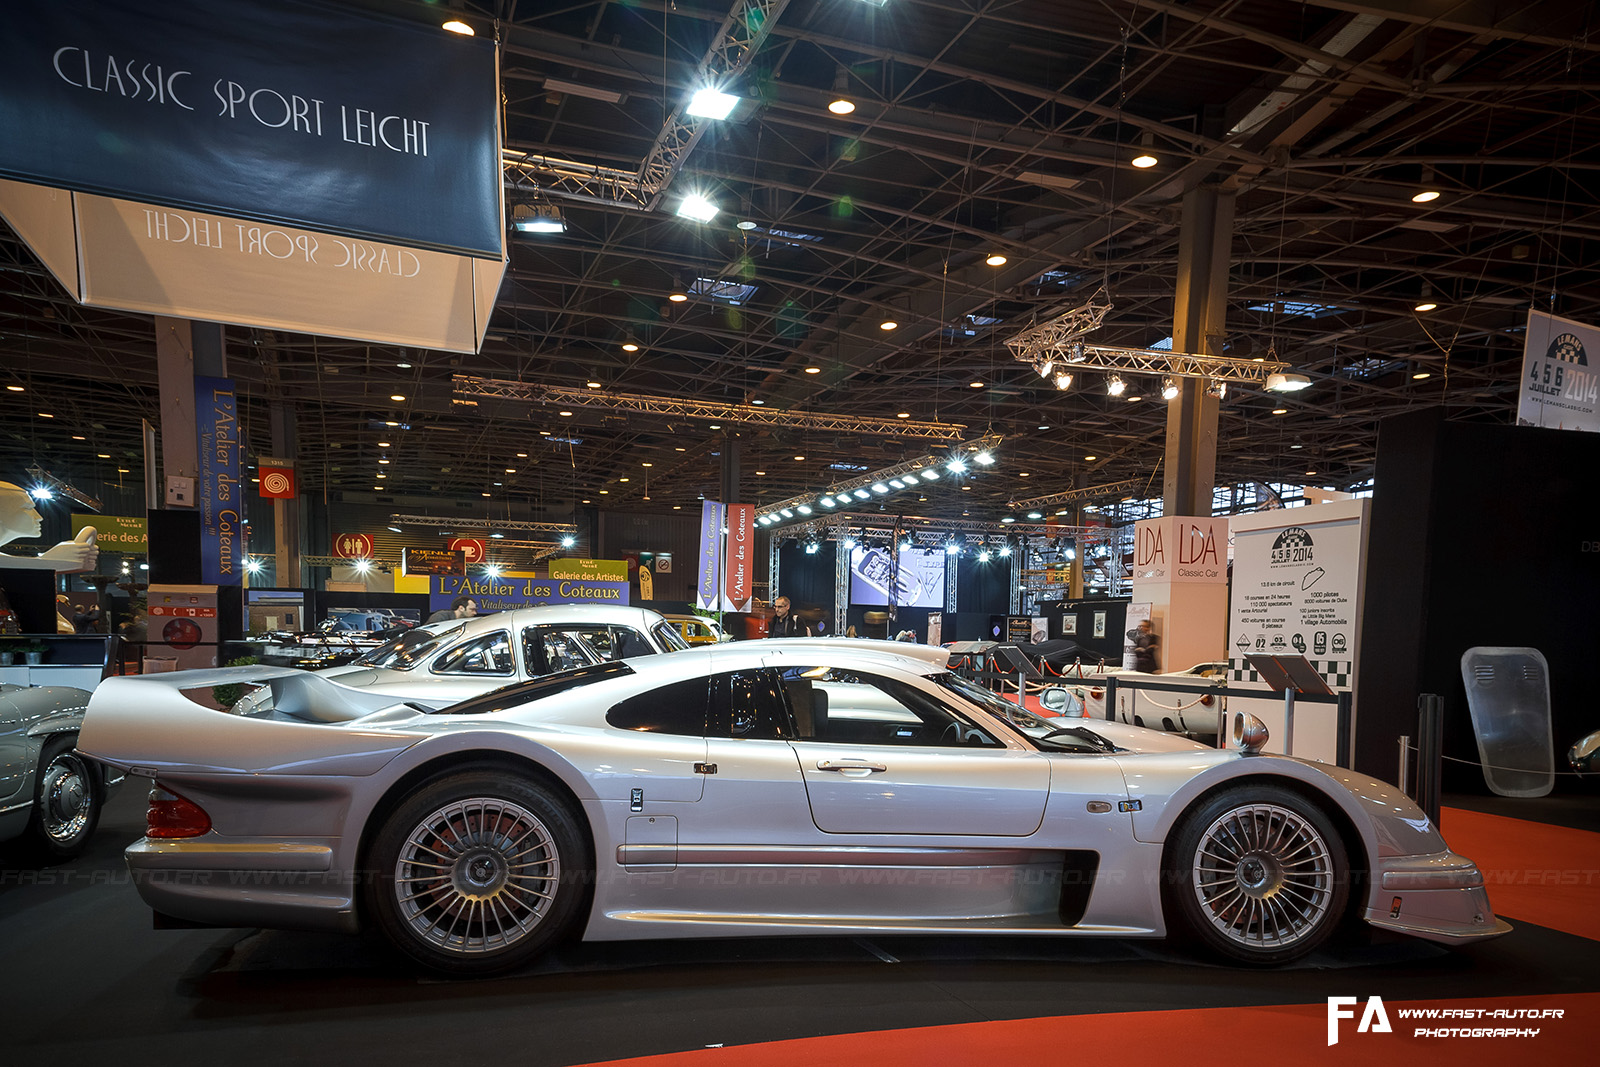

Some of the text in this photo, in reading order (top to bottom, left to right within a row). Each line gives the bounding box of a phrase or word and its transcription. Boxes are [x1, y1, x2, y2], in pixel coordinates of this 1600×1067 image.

[53, 46, 430, 157] CLASSIC SPORT LEICHT
[1530, 361, 1563, 387] 4 5 6
[1529, 382, 1561, 397] JUILLET
[1564, 369, 1597, 404] 2014
[213, 389, 239, 575] L'Atelier des Coteaux
[707, 504, 717, 539] Coteaux
[97, 532, 117, 542] erie
[120, 533, 139, 543] des
[1138, 524, 1164, 566] LDA
[1179, 523, 1218, 565] LDA
[410, 549, 456, 557] KIENLE
[705, 542, 714, 557] des
[734, 508, 746, 601] L'Atelier des Coteaux
[1292, 547, 1314, 563] 2014
[552, 570, 624, 582] Galerie des Artistes
[1155, 568, 1165, 577] Car
[1177, 567, 1219, 578] Classic Car
[438, 576, 515, 596] L'Atelier
[522, 579, 551, 597] des
[558, 580, 620, 599] Coteaux
[481, 599, 518, 610] Vitaliseur
[1255, 638, 1266, 649] 02
